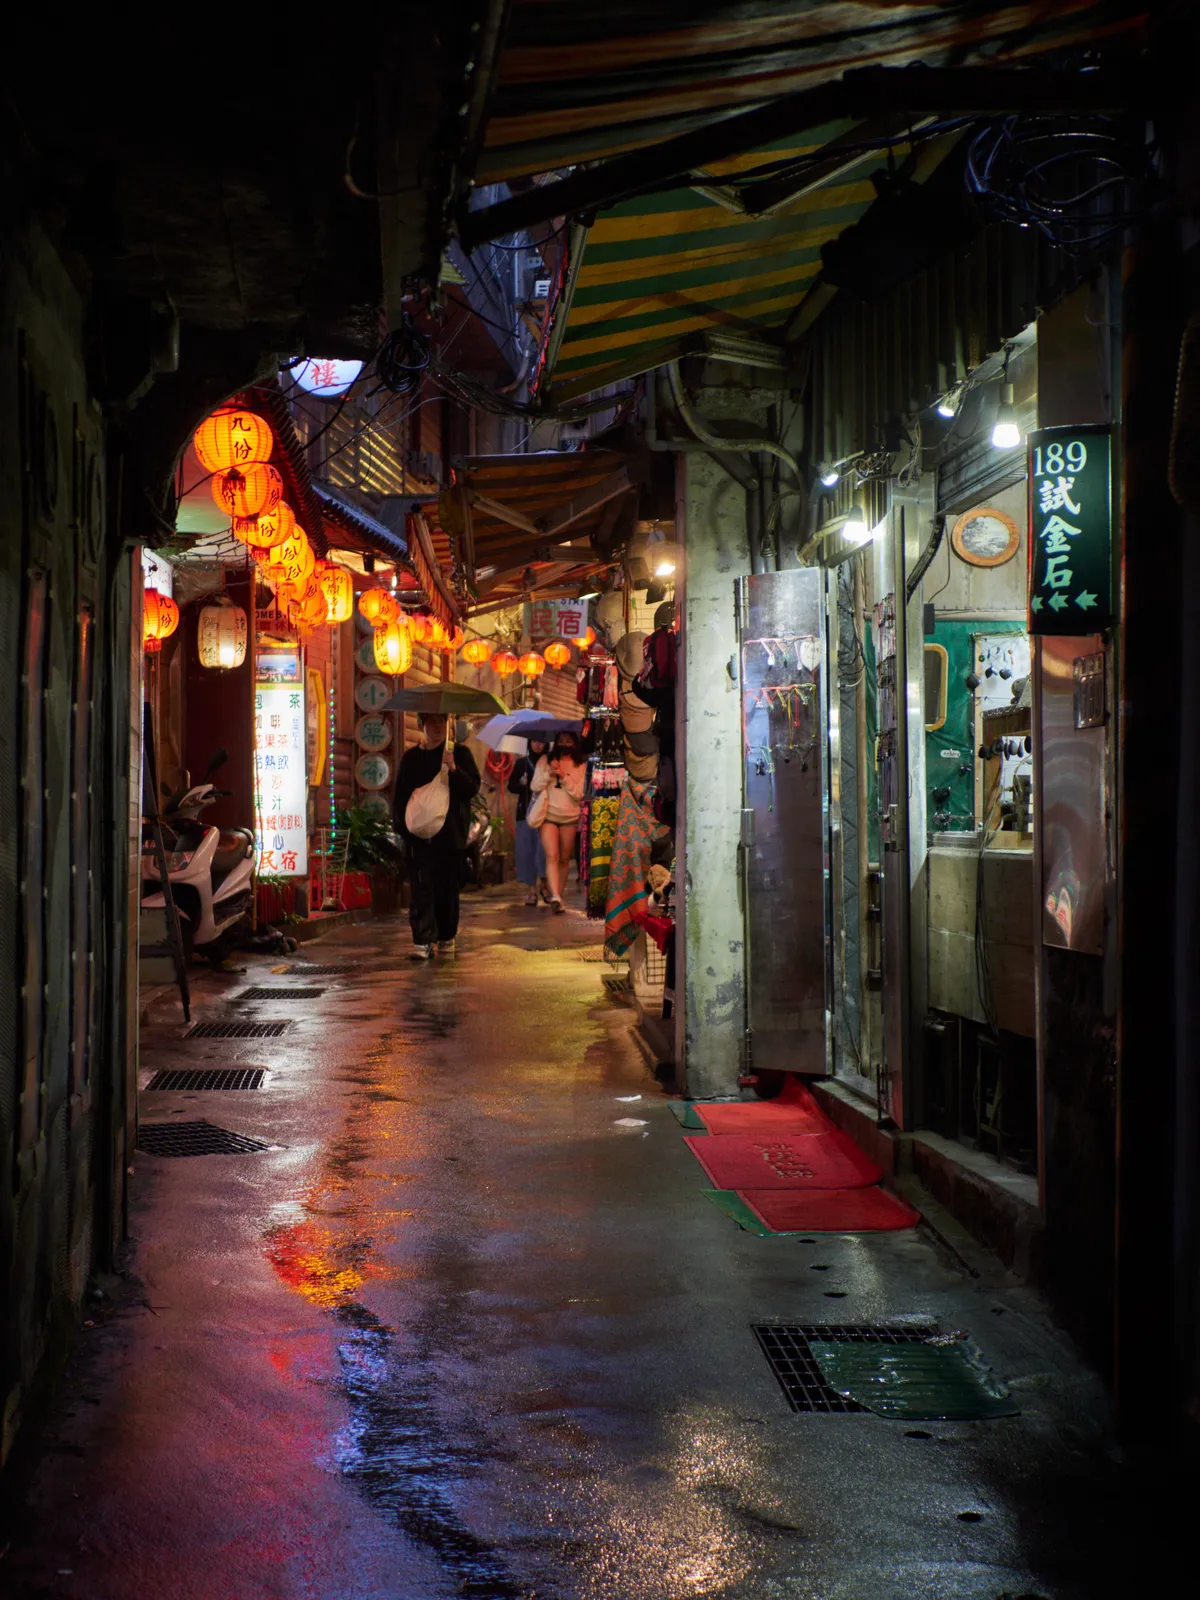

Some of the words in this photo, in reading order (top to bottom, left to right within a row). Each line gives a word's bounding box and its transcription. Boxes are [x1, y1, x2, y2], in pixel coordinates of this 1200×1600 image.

[231, 417, 252, 460] 九份
[1034, 441, 1087, 476] 189
[1039, 476, 1082, 589] 試金石
[160, 597, 172, 628] 九份
[528, 607, 582, 635] 民宿
[260, 850, 298, 871] 民宿
